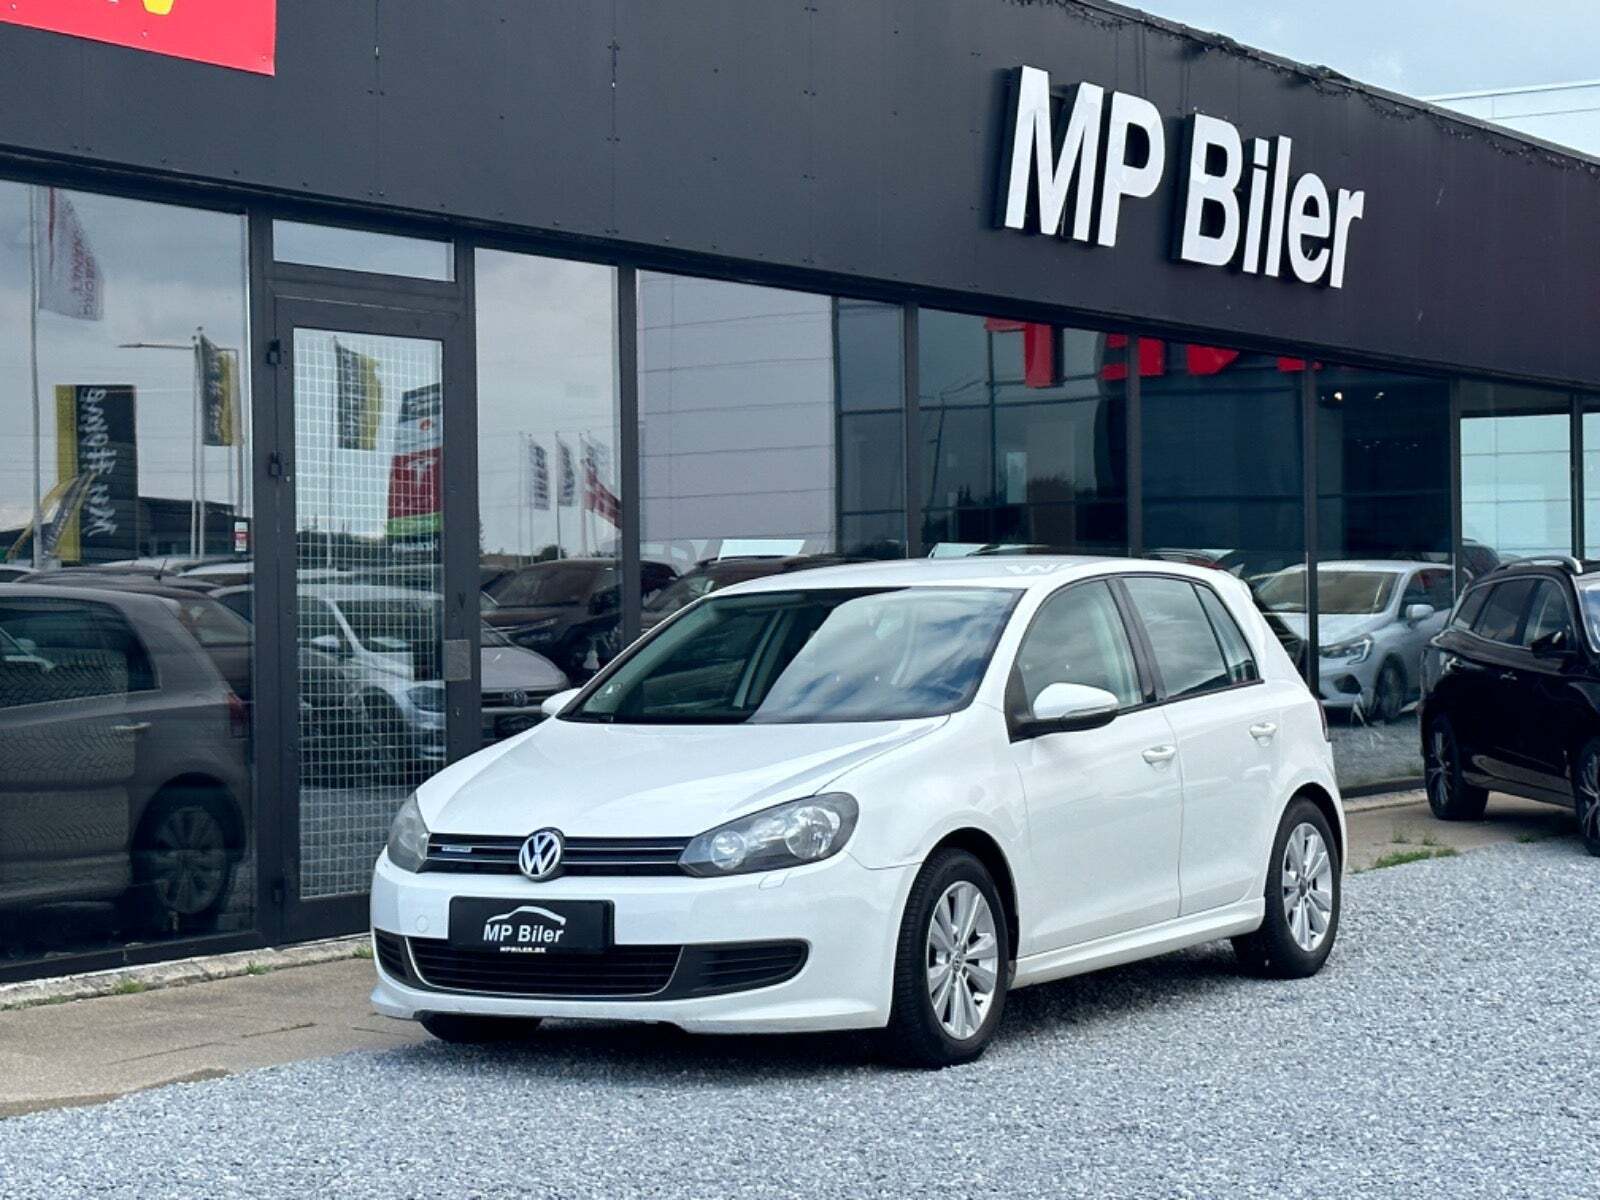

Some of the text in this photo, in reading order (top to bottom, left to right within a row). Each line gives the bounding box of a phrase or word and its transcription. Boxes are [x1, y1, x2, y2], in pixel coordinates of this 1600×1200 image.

[1005, 66, 1365, 289] MP Biler
[519, 831, 562, 879] VW
[483, 924, 565, 943] MP Biler
